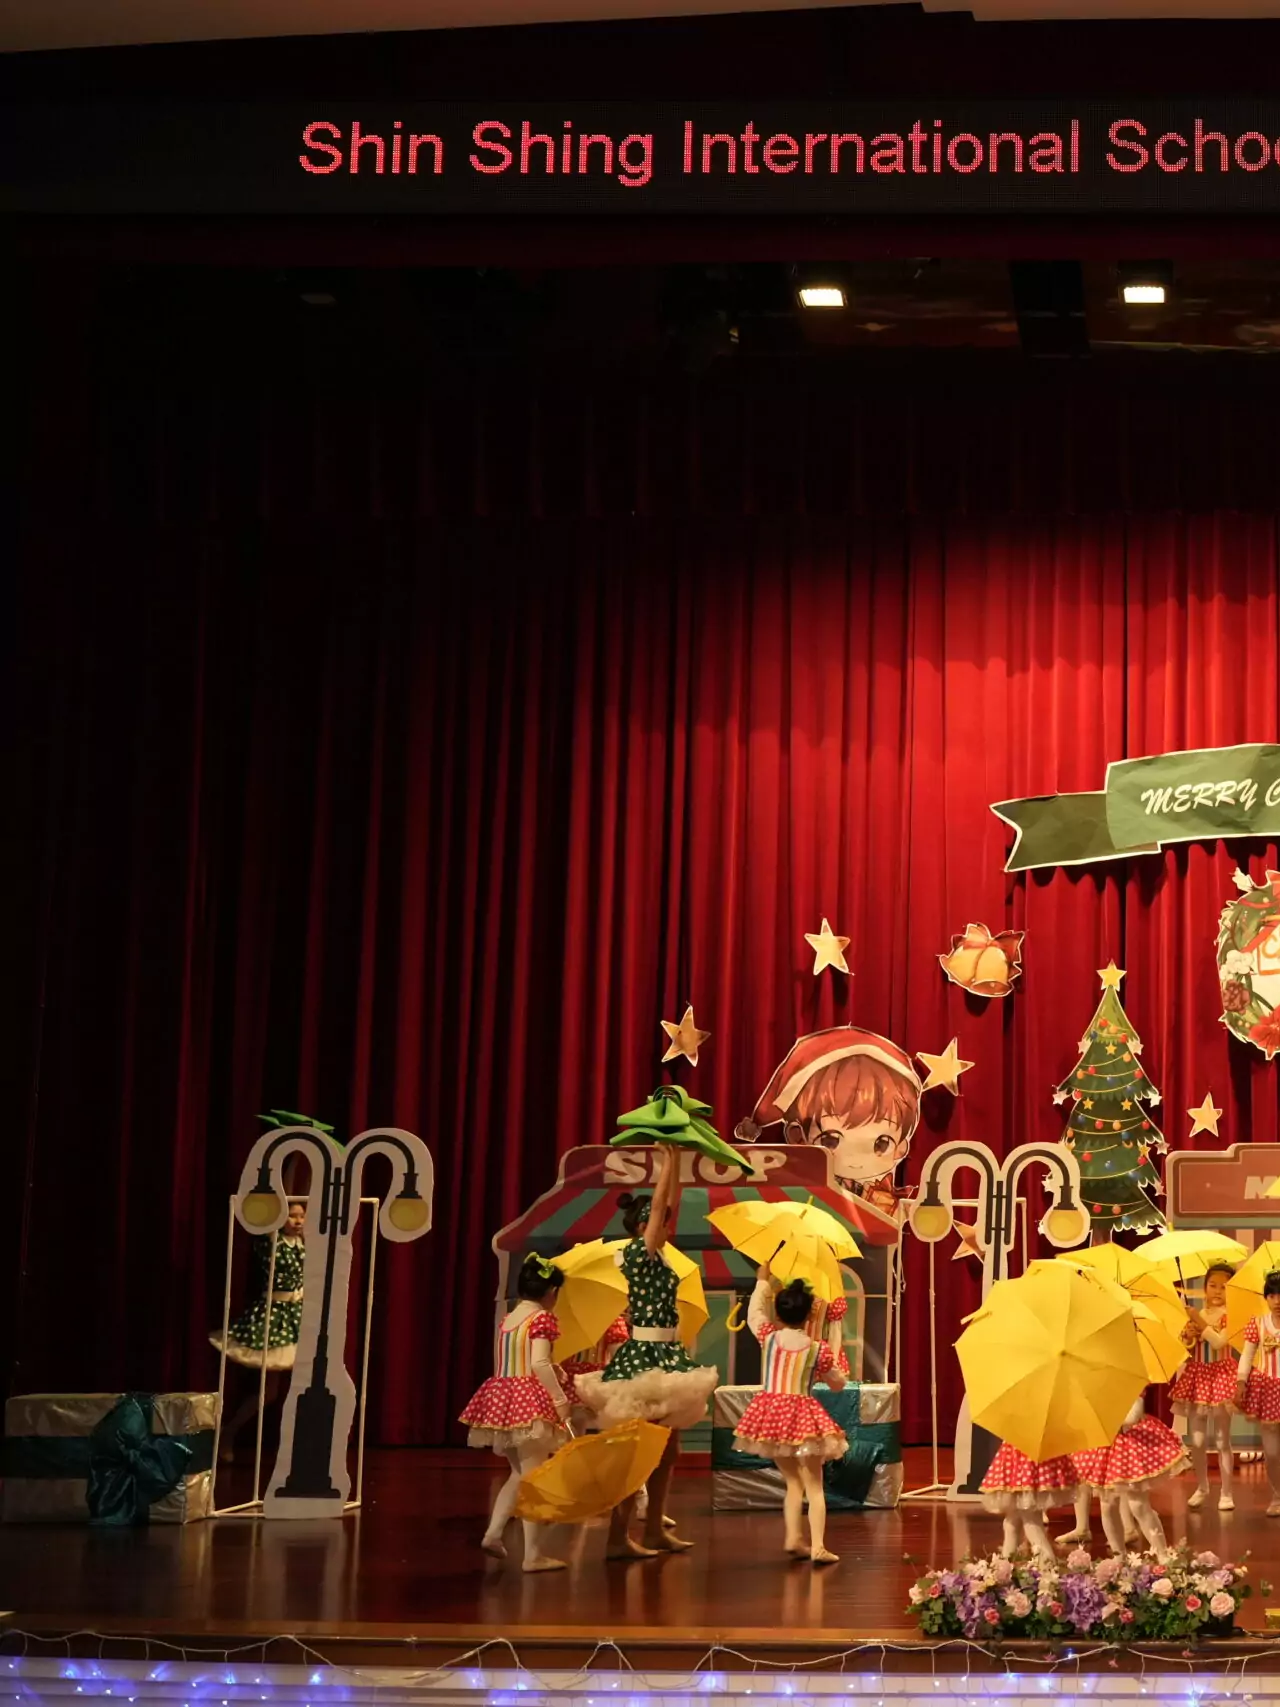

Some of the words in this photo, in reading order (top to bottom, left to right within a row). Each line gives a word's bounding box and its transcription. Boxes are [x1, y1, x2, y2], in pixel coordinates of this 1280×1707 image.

[300, 122, 443, 175] Shin
[470, 121, 654, 187] Shing
[684, 120, 1079, 174] International
[1141, 779, 1257, 814] MERRY
